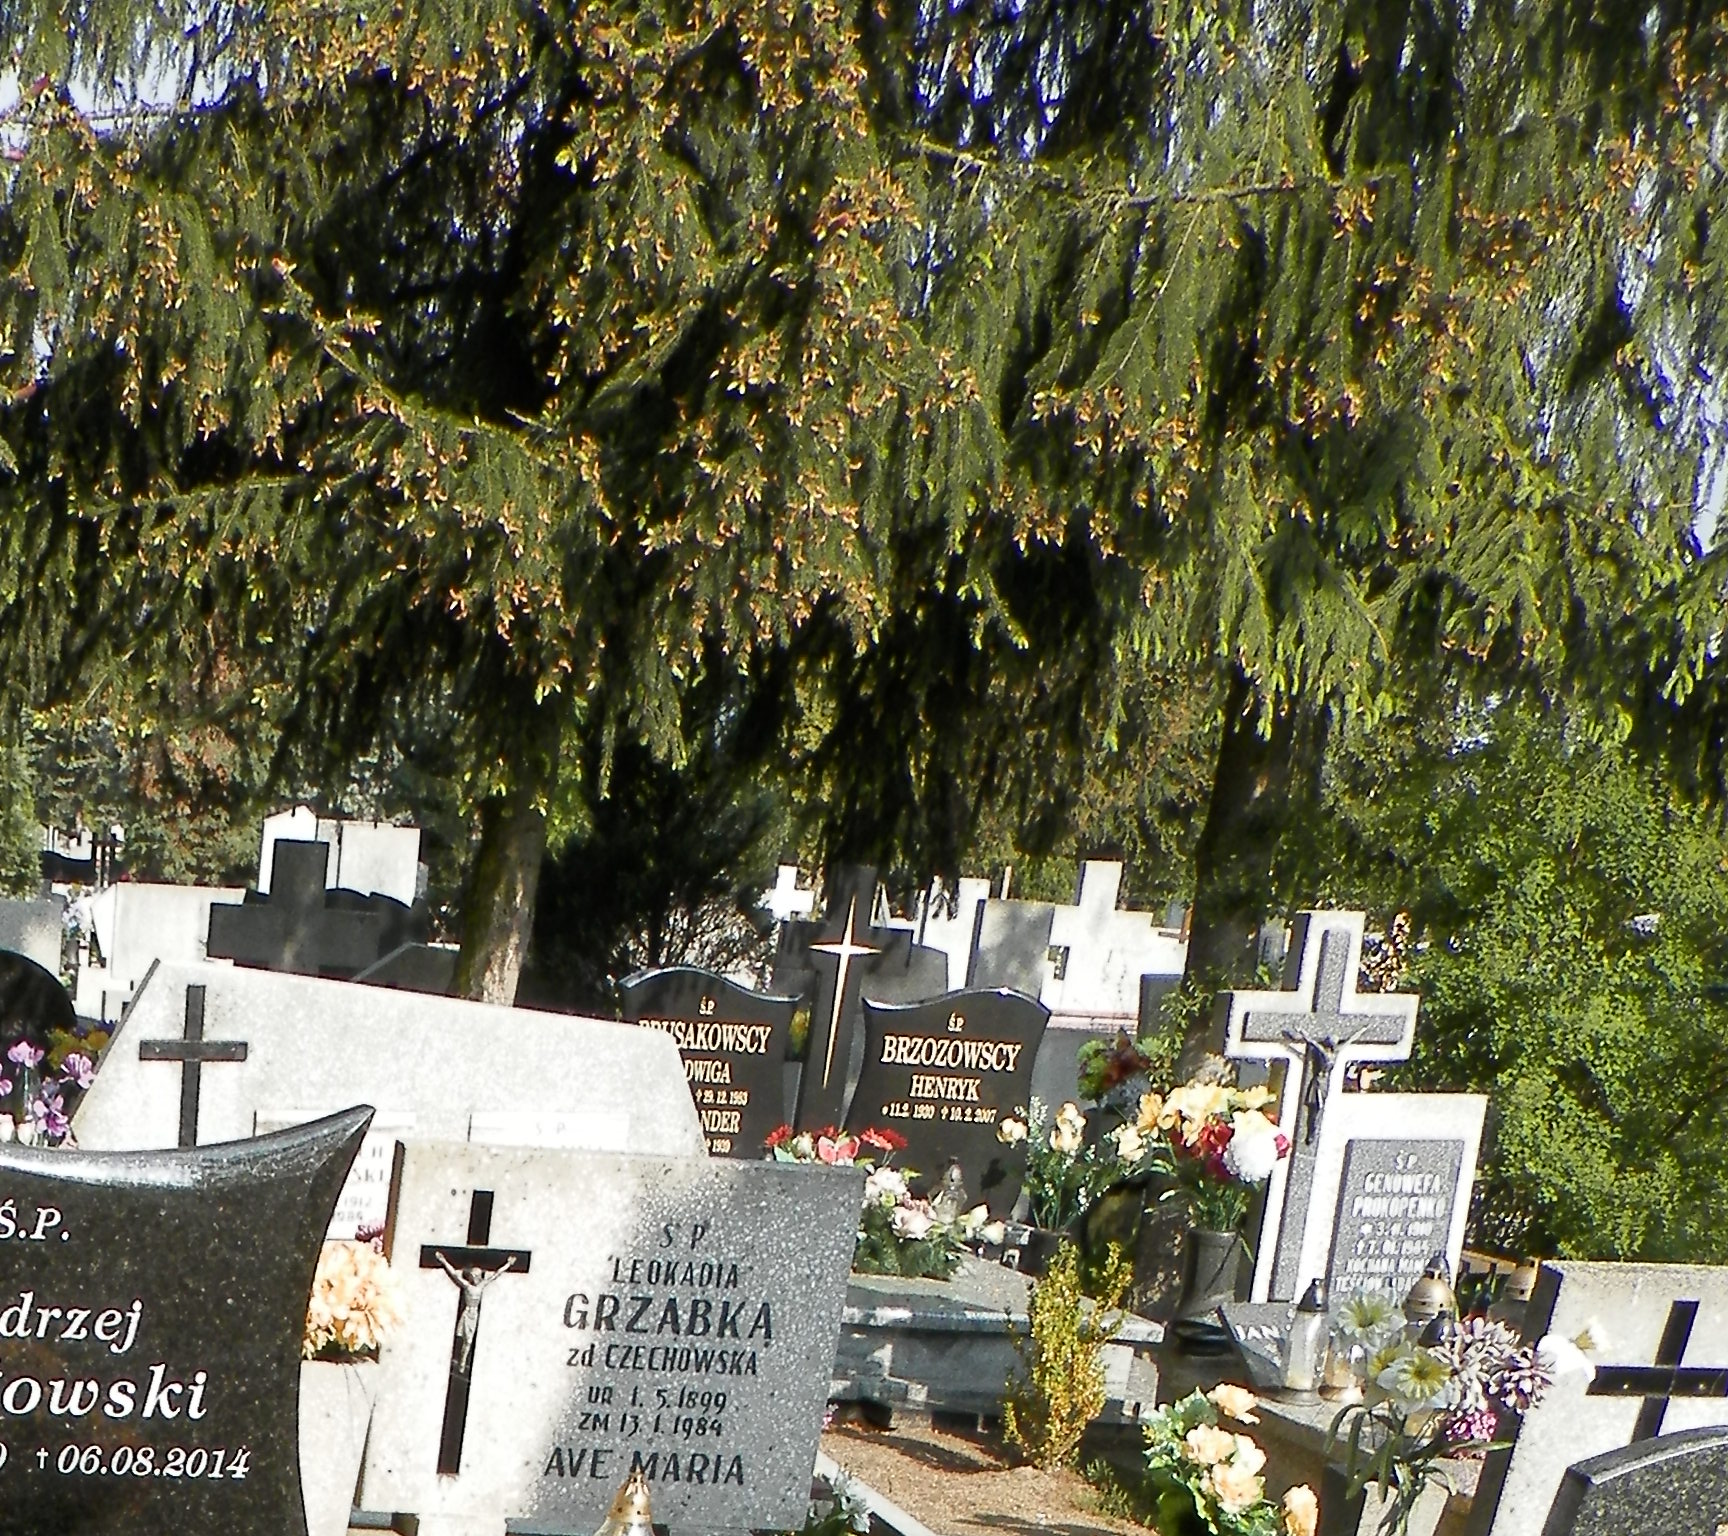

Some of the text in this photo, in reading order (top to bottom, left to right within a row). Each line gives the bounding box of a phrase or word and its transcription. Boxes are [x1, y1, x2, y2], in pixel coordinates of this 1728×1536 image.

[881, 1035, 1021, 1072] BRZOZOWSCY
[910, 1075, 980, 1101] HENRYK
[605, 1344, 757, 1376] CZECHOWSKA
[544, 1446, 744, 1486] AVE MARIA
